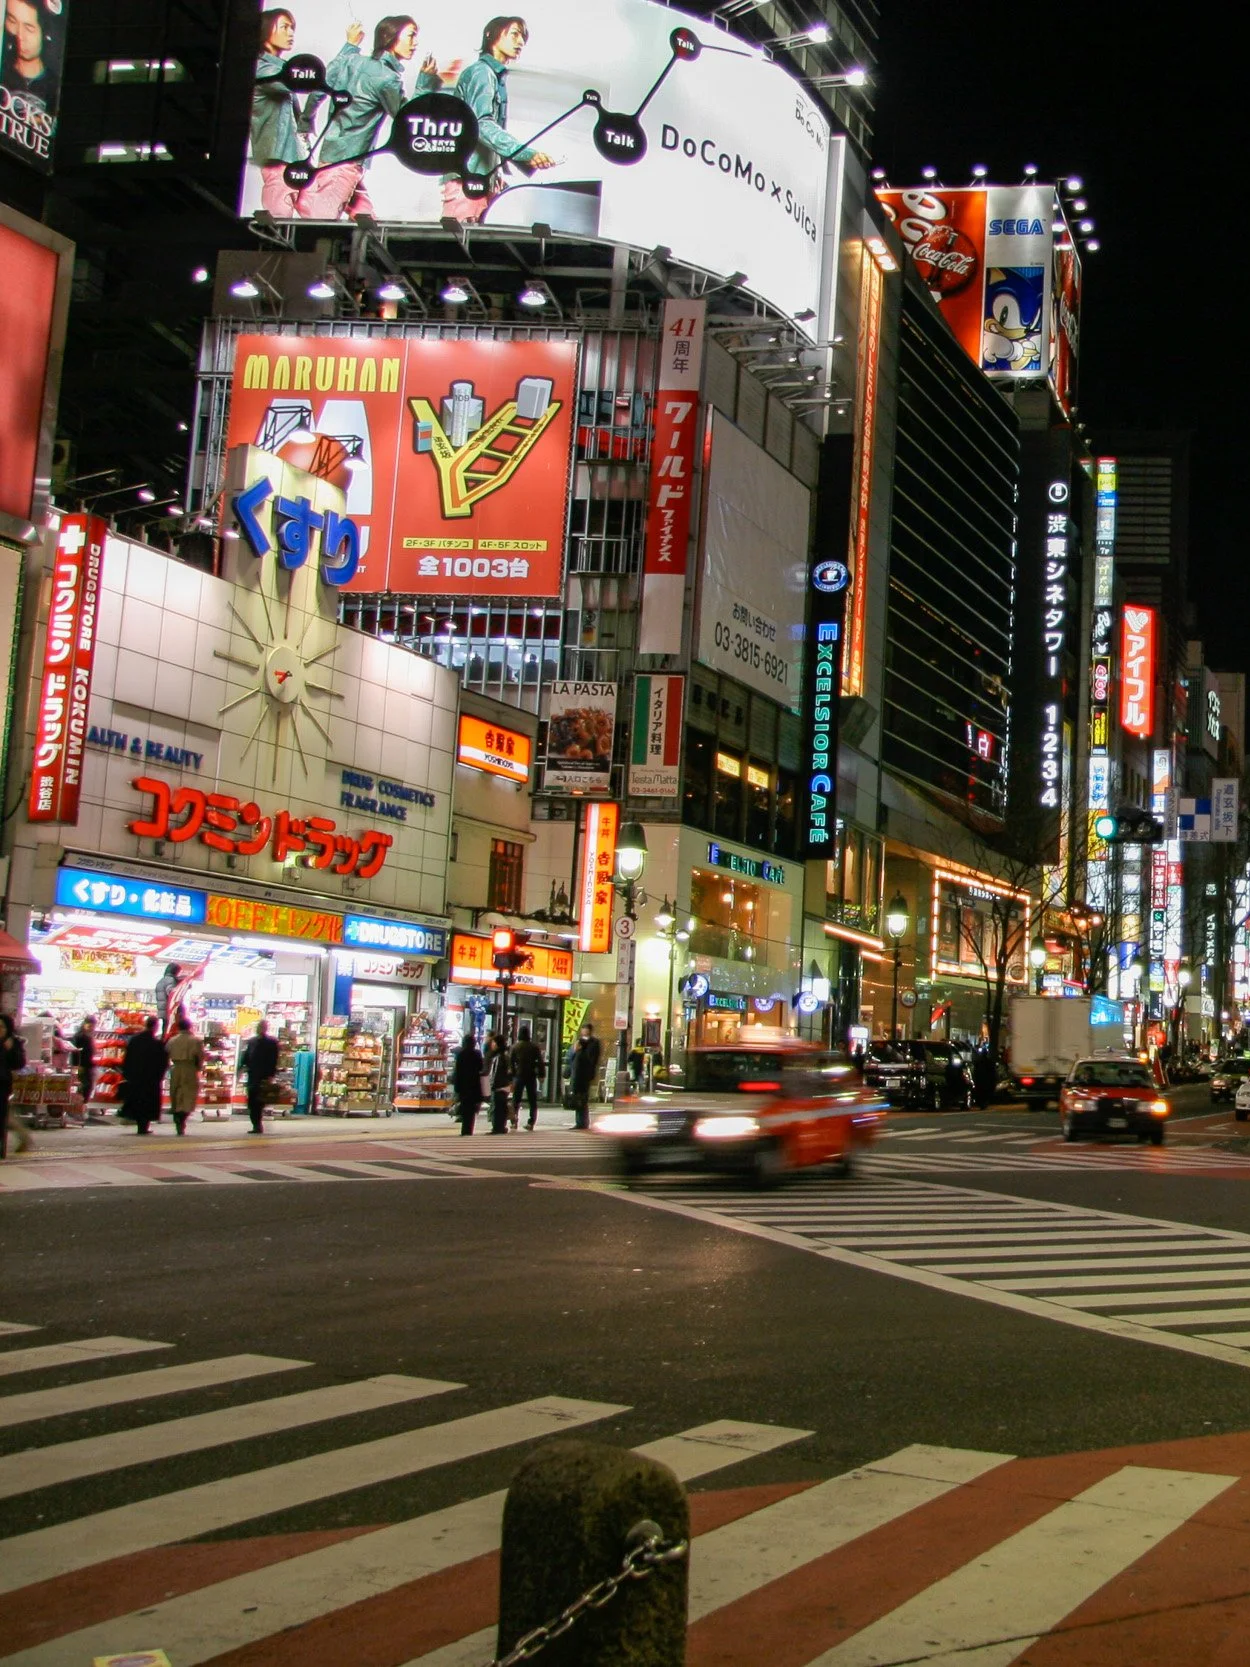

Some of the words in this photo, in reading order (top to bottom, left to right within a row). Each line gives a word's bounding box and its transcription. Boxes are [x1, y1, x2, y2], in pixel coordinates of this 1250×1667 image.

[677, 37, 695, 51] Talk
[292, 68, 316, 80] Talk
[0, 112, 50, 158] TRUE
[408, 117, 463, 137] Thru
[605, 130, 635, 149] Talk
[291, 170, 308, 181] Talk
[467, 183, 484, 191] Talk
[989, 218, 1044, 235] SEGA
[243, 355, 400, 392] MARUHAN
[233, 476, 361, 585] くすり
[438, 540, 470, 548] パチンコ
[513, 542, 542, 550] スロット
[418, 556, 529, 578] 全1003台
[78, 543, 101, 651] DRUGSTORE
[1046, 514, 1068, 677] 渋東シネタワー
[732, 601, 777, 644] お問い合わせ
[714, 621, 789, 686] 03-3815-6921
[552, 682, 570, 695] LA
[574, 683, 615, 697] PASTA
[813, 623, 838, 769] EXCELSIOR
[1125, 634, 1146, 726] アイフル
[65, 667, 89, 785] KOKUMIN
[650, 687, 663, 755] イタリア料理
[145, 740, 204, 769] BEAUTY
[809, 774, 831, 843] CAFÉ
[1222, 783, 1235, 836] 道玄坂下
[128, 775, 394, 878] コクミンドラッグ
[359, 919, 442, 952] DRUGSTORE
[620, 920, 630, 935] 3
[458, 944, 477, 961] 牛丼
